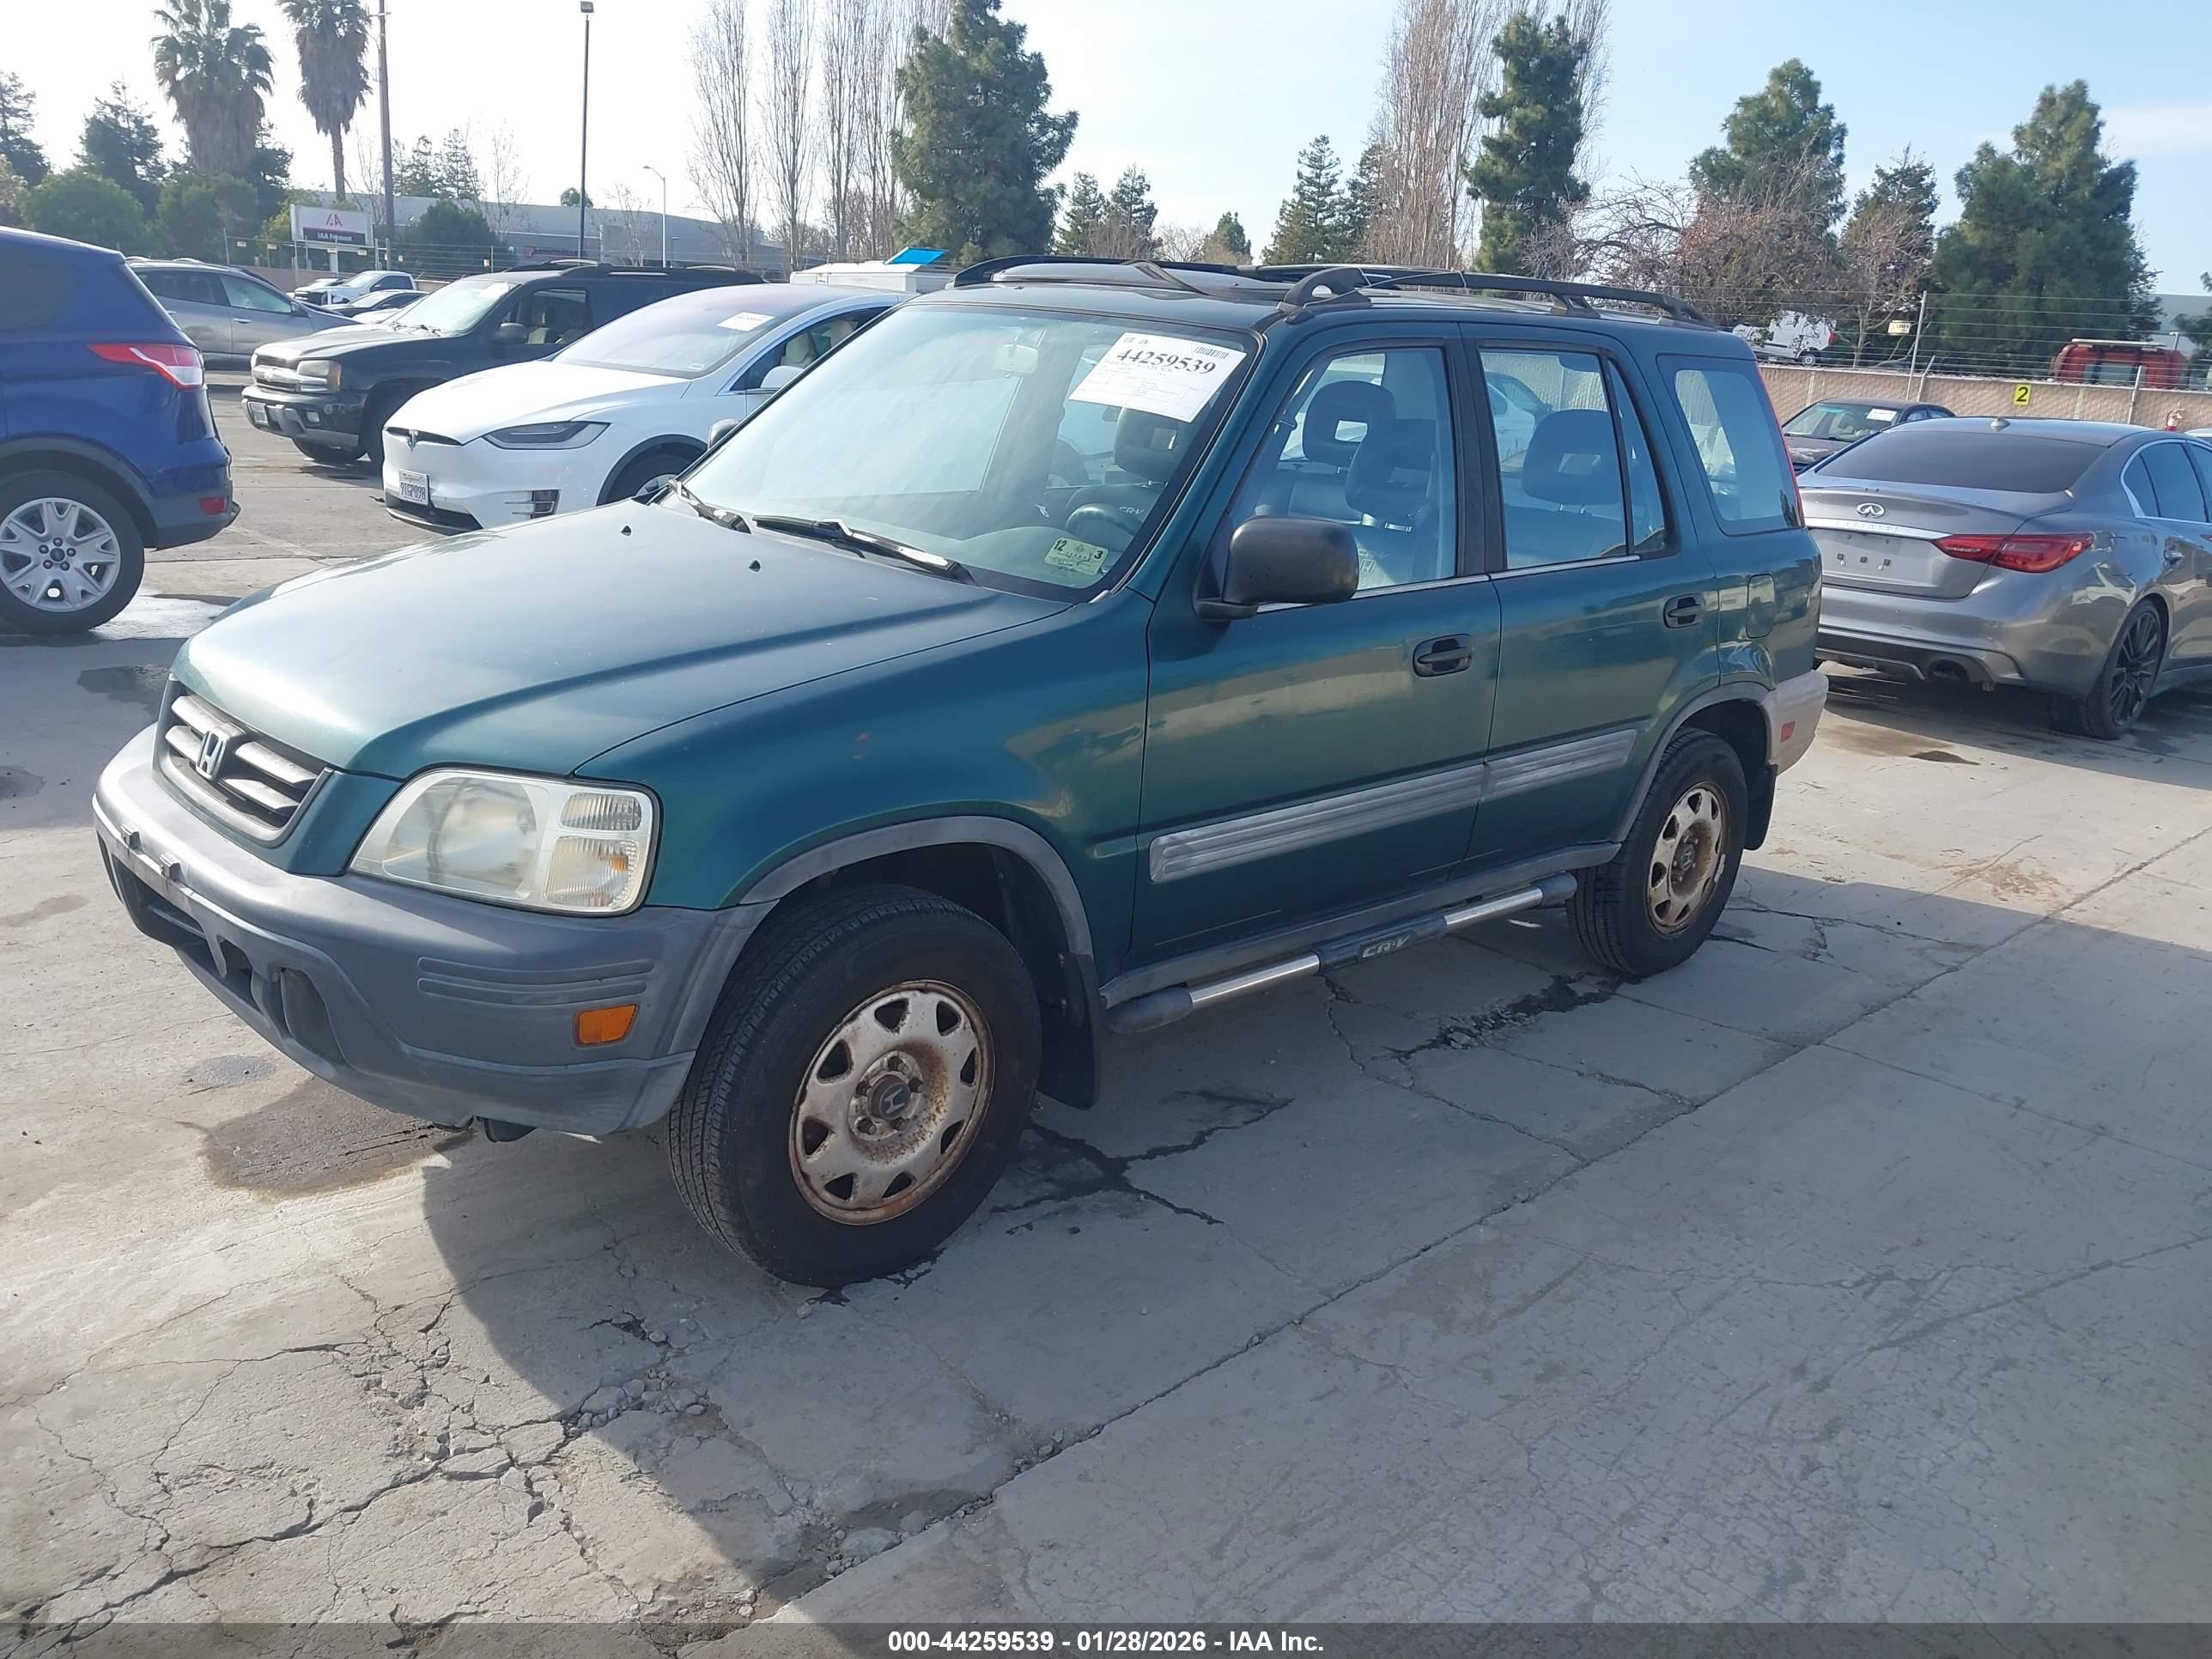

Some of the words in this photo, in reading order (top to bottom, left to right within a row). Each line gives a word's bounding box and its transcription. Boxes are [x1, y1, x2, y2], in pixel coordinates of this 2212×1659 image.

[1117, 349, 1217, 374] 44259539
[2015, 386, 2028, 402] 2
[1053, 539, 1067, 551] 12
[1093, 550, 1103, 560] 3
[1362, 934, 1411, 958] CR-V
